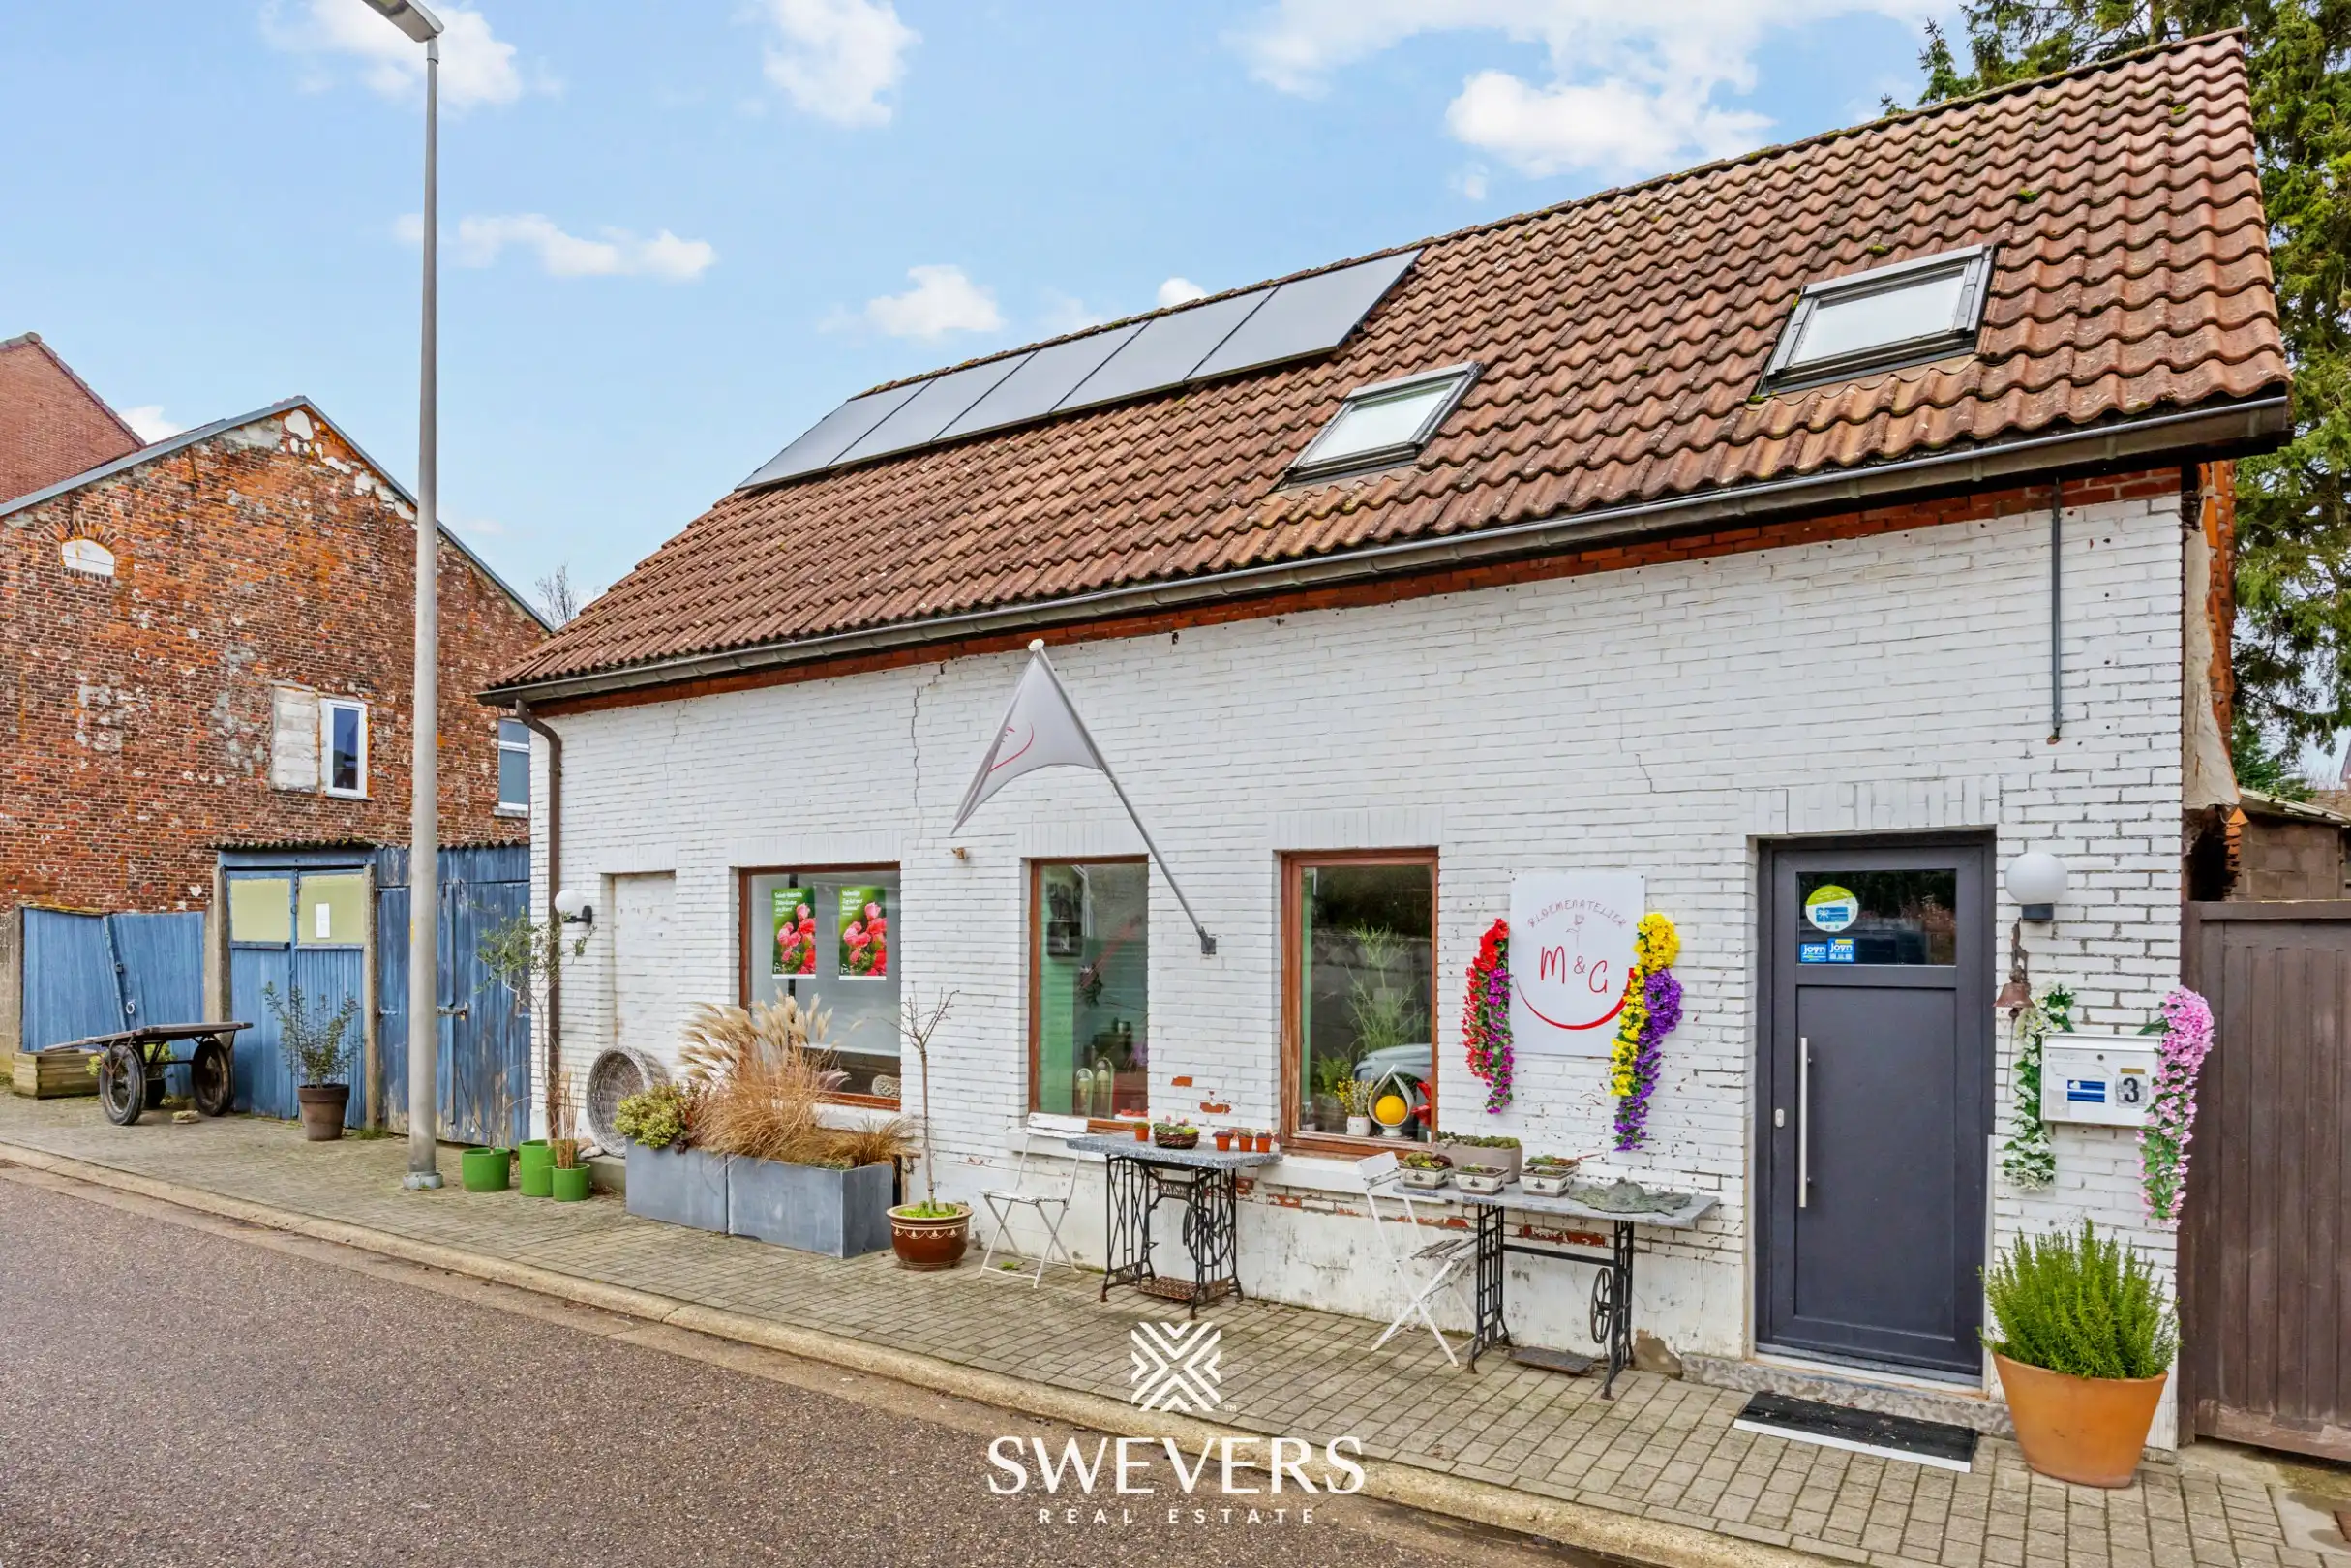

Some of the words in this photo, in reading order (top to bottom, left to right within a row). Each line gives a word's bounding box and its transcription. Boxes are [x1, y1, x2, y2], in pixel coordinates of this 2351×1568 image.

[1527, 899, 1627, 928] BLOEMENATELIER
[1540, 945, 1566, 984] M
[1573, 955, 1586, 975] &
[2123, 1077, 2140, 1103] 3
